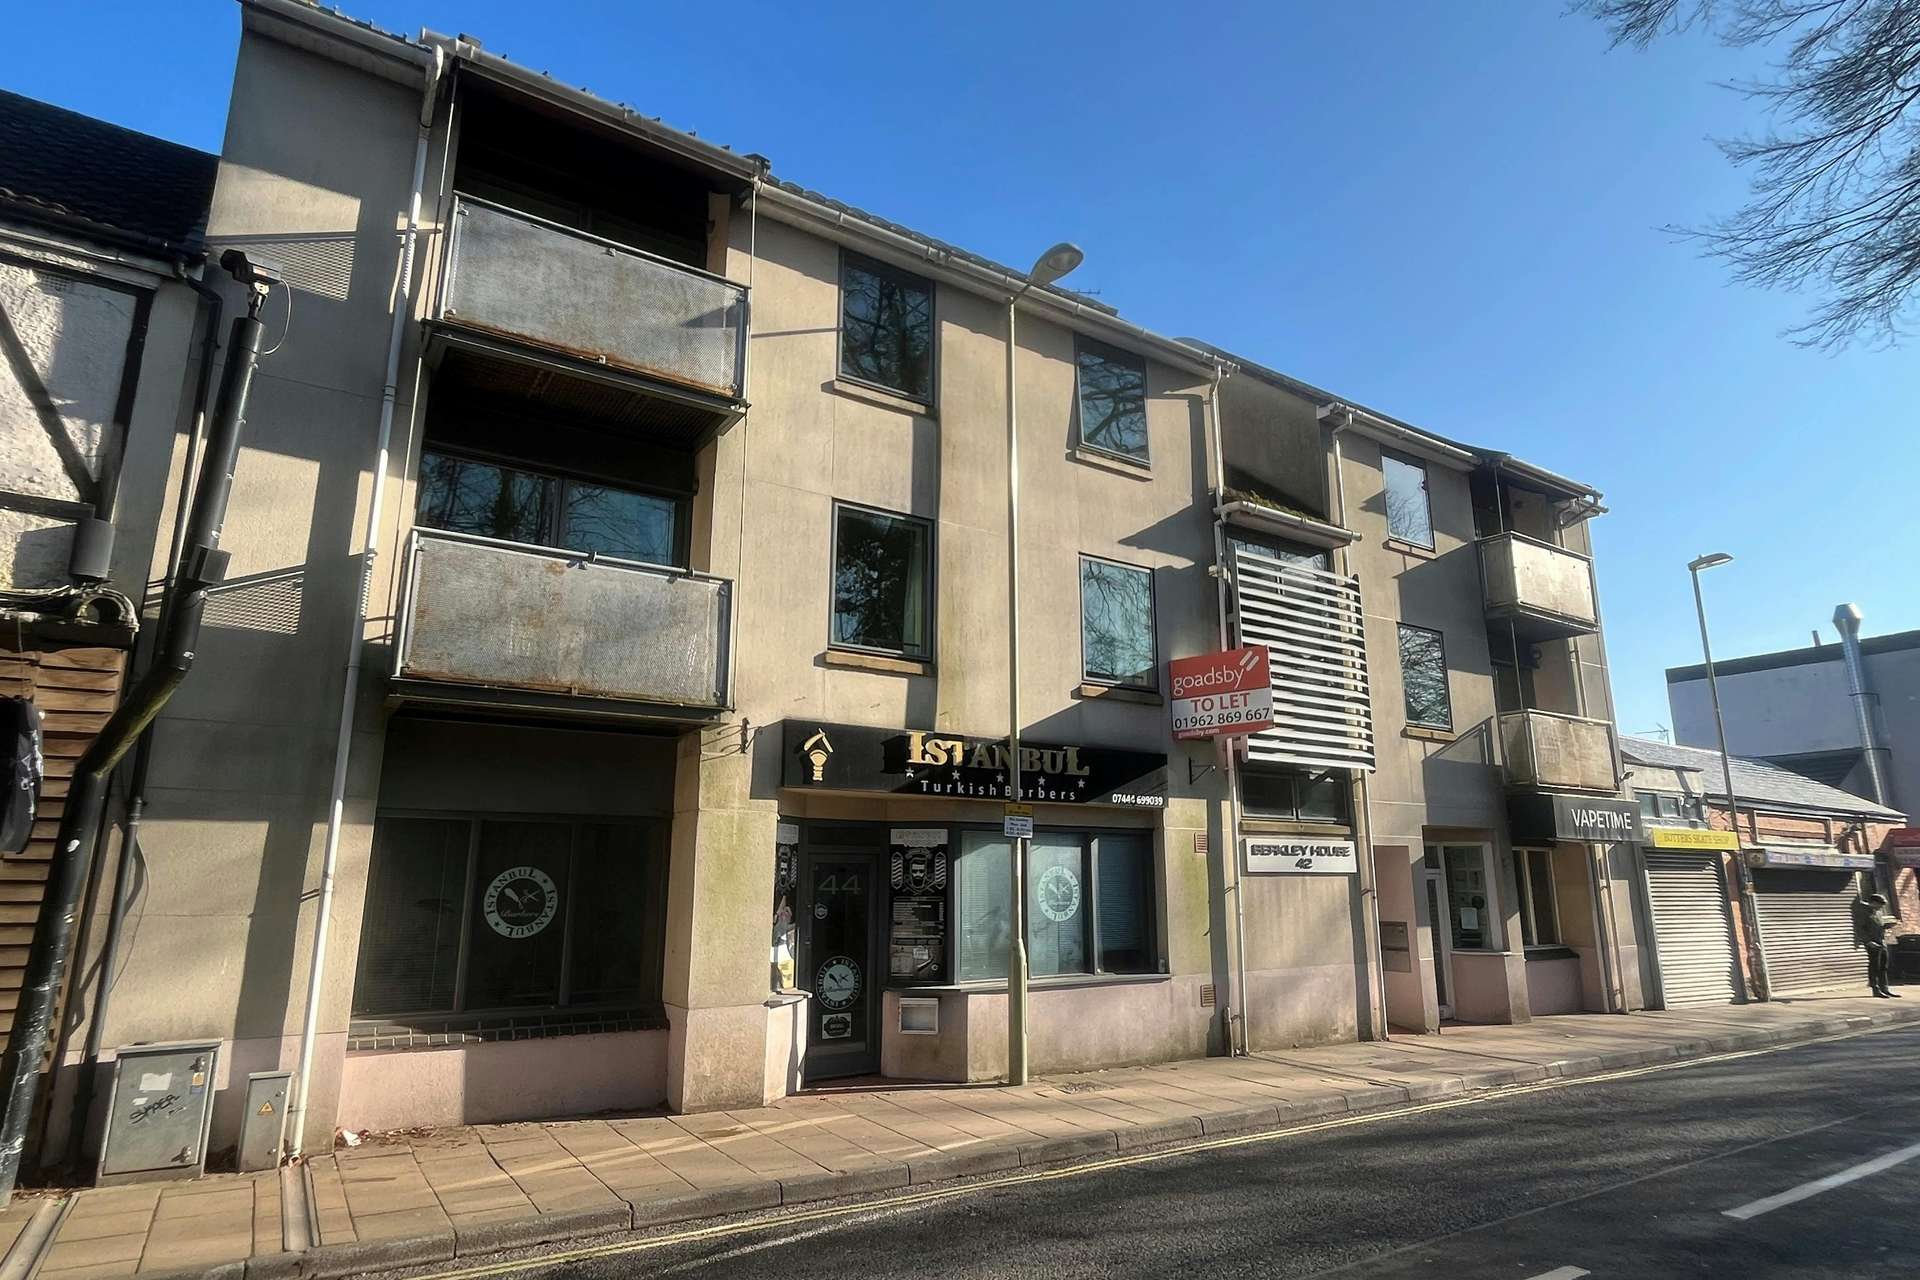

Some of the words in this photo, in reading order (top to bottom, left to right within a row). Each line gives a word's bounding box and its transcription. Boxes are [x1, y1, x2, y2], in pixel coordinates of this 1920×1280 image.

[1173, 665, 1244, 697] goadsby
[1191, 698, 1214, 713] TO
[1220, 693, 1250, 709] LET
[1175, 715, 1214, 729] 01962
[1217, 711, 1242, 724] 869
[1245, 708, 1270, 721] 667
[907, 731, 1090, 775] ISTANBUL
[921, 780, 997, 796] Turkish
[1571, 808, 1633, 830] VAPETIME
[1310, 845, 1351, 857] HOUSE
[1295, 858, 1313, 870] 42
[486, 869, 536, 916] ISTANBUL
[817, 874, 862, 895] 44
